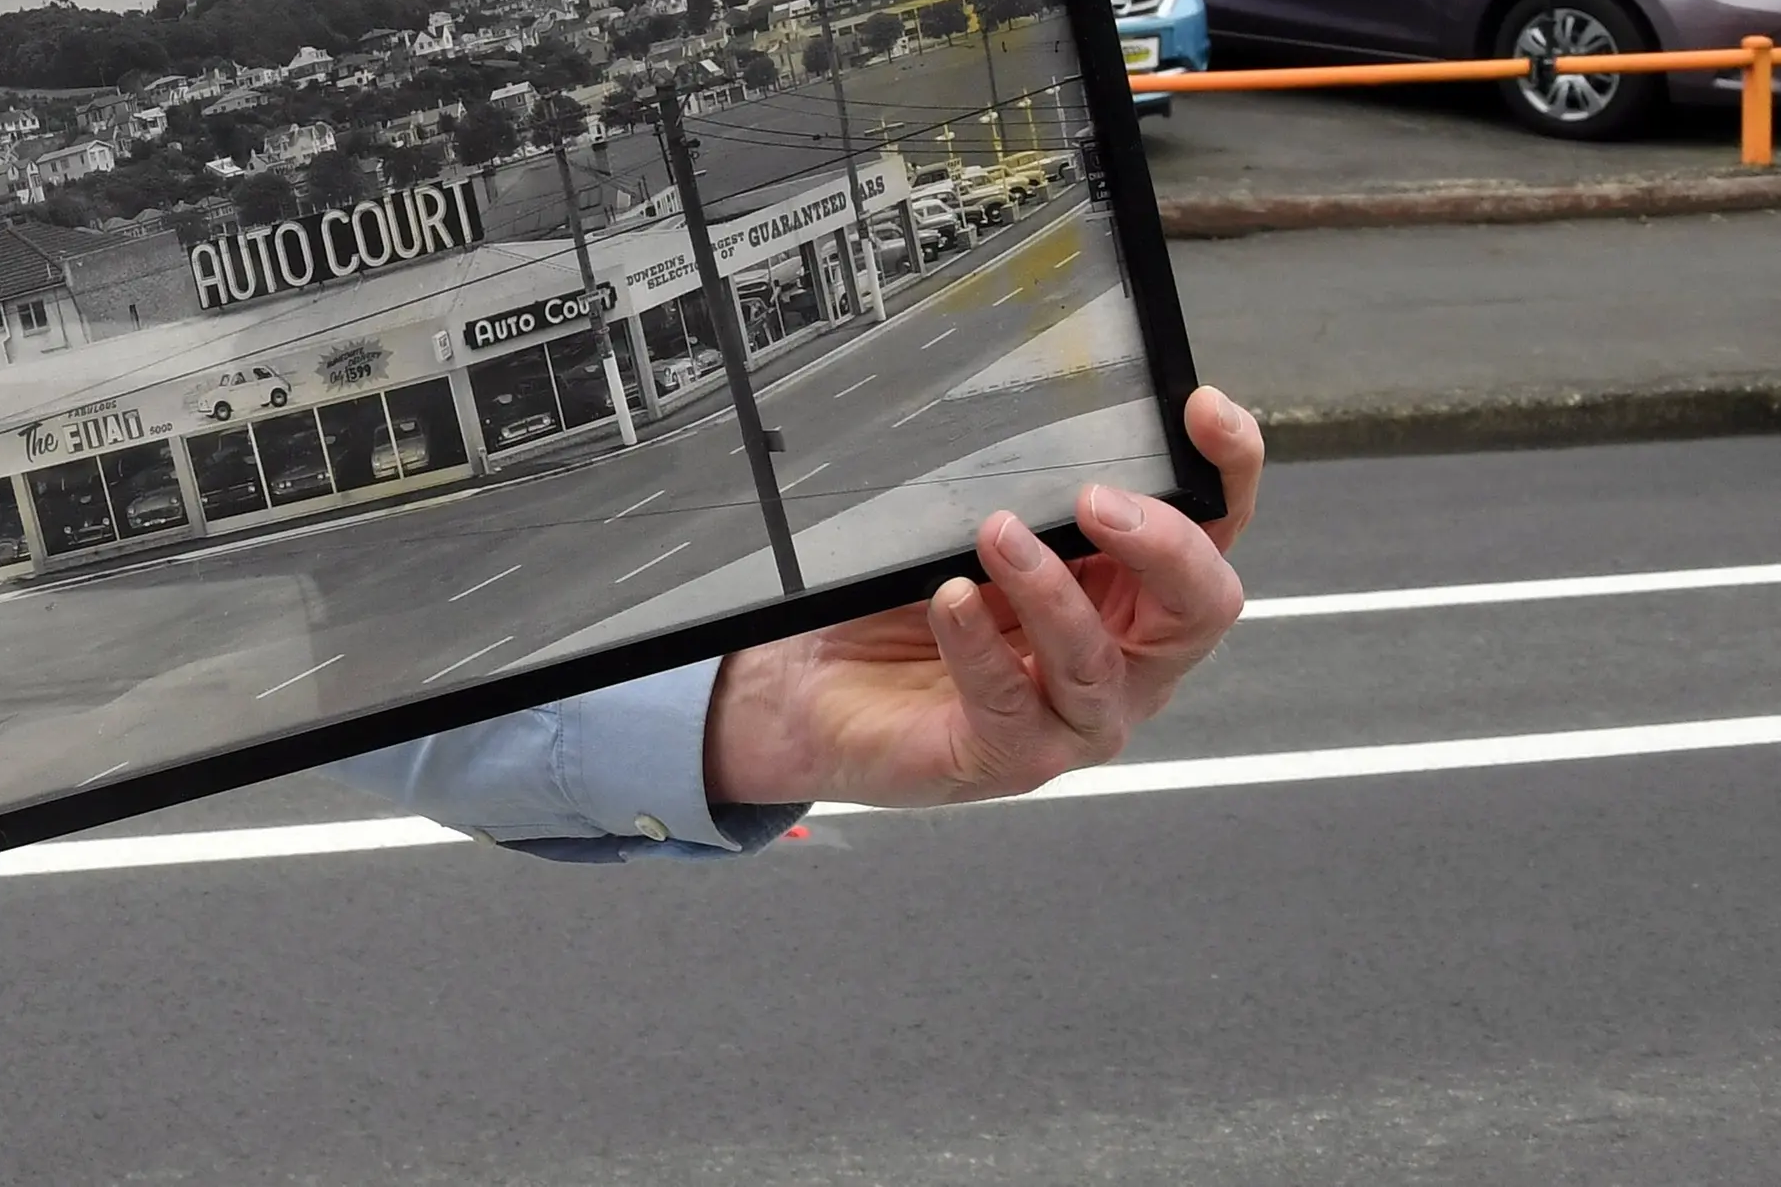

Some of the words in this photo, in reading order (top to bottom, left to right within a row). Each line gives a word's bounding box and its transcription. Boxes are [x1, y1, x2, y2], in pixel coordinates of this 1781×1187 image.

[748, 191, 847, 247] GUARANTEED
[858, 175, 885, 202] ARS
[191, 220, 314, 308] AUTO
[320, 179, 473, 276] COURT
[626, 255, 685, 286] DUNEDIN'S
[711, 230, 745, 253] RGEST
[647, 263, 700, 290] SELECTI
[17, 422, 59, 463] The
[62, 409, 145, 454] FIAT
